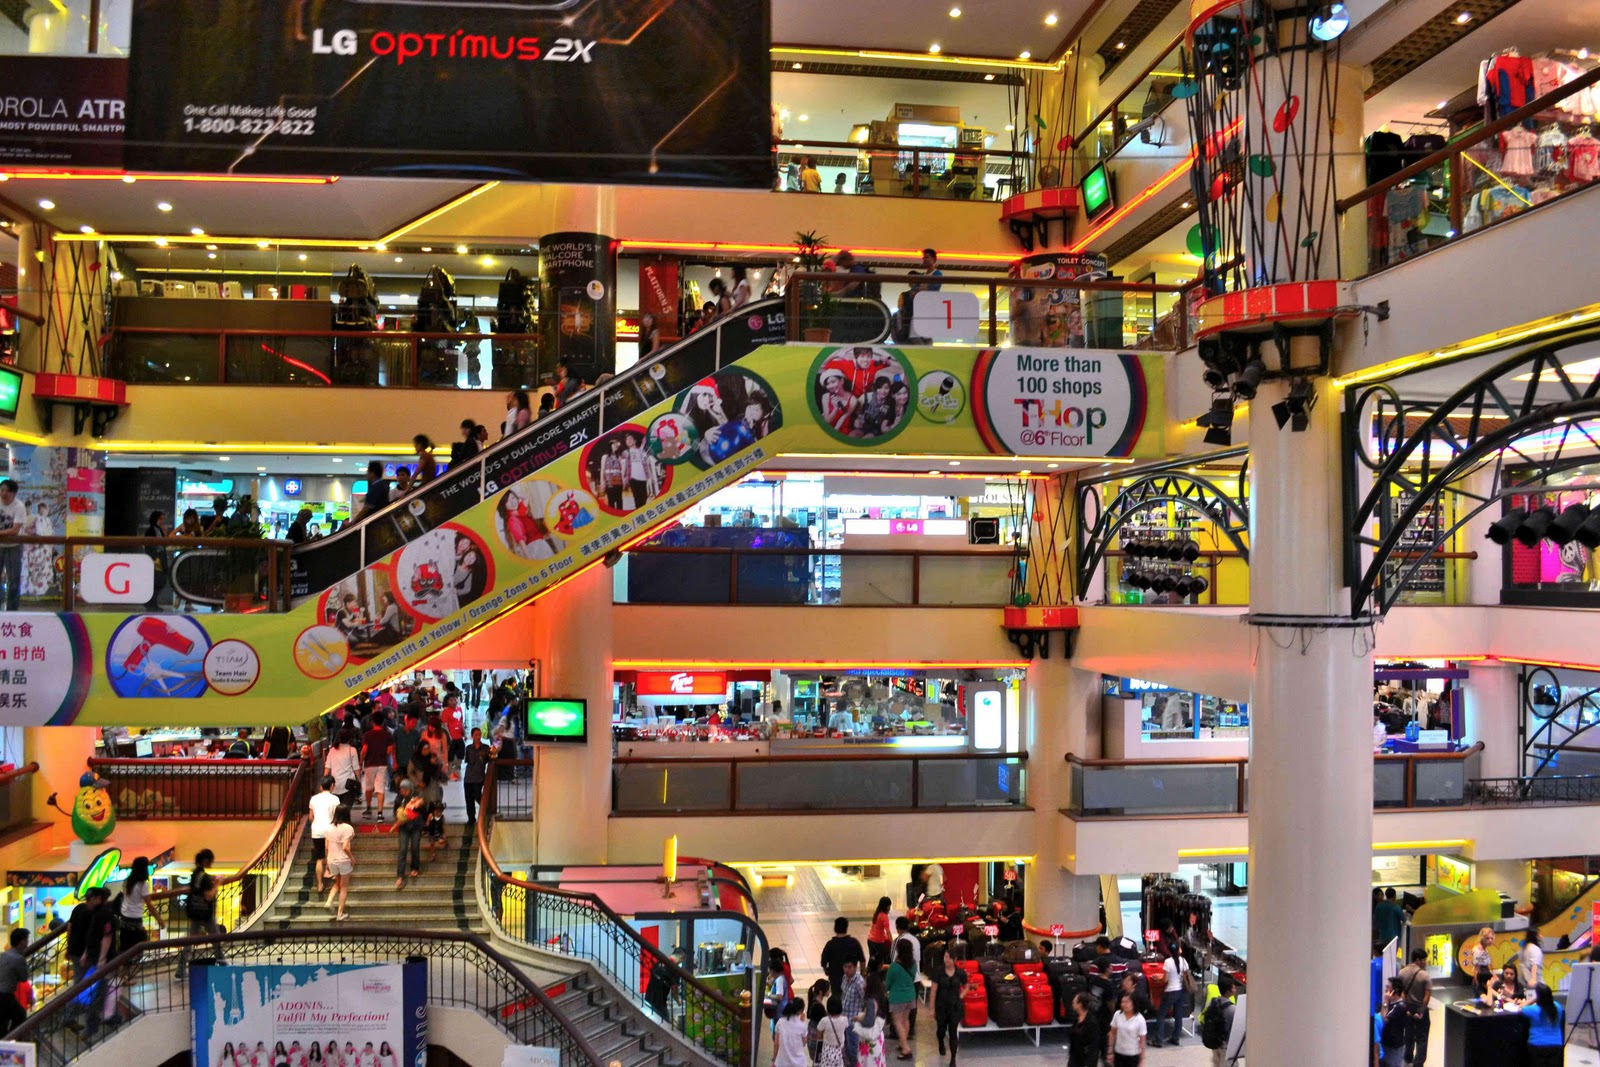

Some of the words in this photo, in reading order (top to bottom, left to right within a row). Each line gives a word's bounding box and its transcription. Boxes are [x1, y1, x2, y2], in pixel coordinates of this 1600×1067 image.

[312, 28, 357, 55] LG
[543, 38, 597, 63] 2X
[0, 96, 68, 118] ROLA
[184, 103, 208, 116] One
[208, 104, 230, 116] Call
[229, 104, 265, 117] Makes
[265, 105, 286, 118] Life
[287, 106, 317, 118] Good
[28, 123, 80, 132] POWERFUL
[184, 117, 316, 135] 1-800-822-822
[551, 242, 593, 252] WORLD'S
[1057, 257, 1079, 265] TOILET
[1081, 258, 1106, 267] CONCEPT
[644, 265, 669, 309] PLATFORM
[766, 313, 785, 324] LG
[942, 299, 952, 329] 1
[1017, 354, 1060, 372] More
[1064, 355, 1101, 373] than
[1017, 376, 1047, 393] 100
[1052, 377, 1102, 398] shops
[569, 427, 589, 449] 2X
[1051, 431, 1085, 447] Floor
[440, 484, 460, 500] THE
[511, 424, 563, 461] DUAL-CORE
[104, 562, 131, 595] G
[344, 672, 364, 689] Use
[365, 652, 401, 677] nearest
[401, 643, 418, 658] lift
[419, 633, 431, 645] at
[429, 617, 462, 641] Yellow
[468, 595, 504, 619] Orange
[504, 582, 528, 599] Zone
[528, 574, 540, 586] to
[541, 568, 549, 578] 6
[548, 554, 574, 575] Floor
[14, 645, 46, 661] 时尚
[276, 1000, 334, 1011] ADONIS...
[276, 1012, 307, 1024] Fulfil
[310, 1013, 327, 1024] My
[331, 1011, 390, 1024] Perfection!
